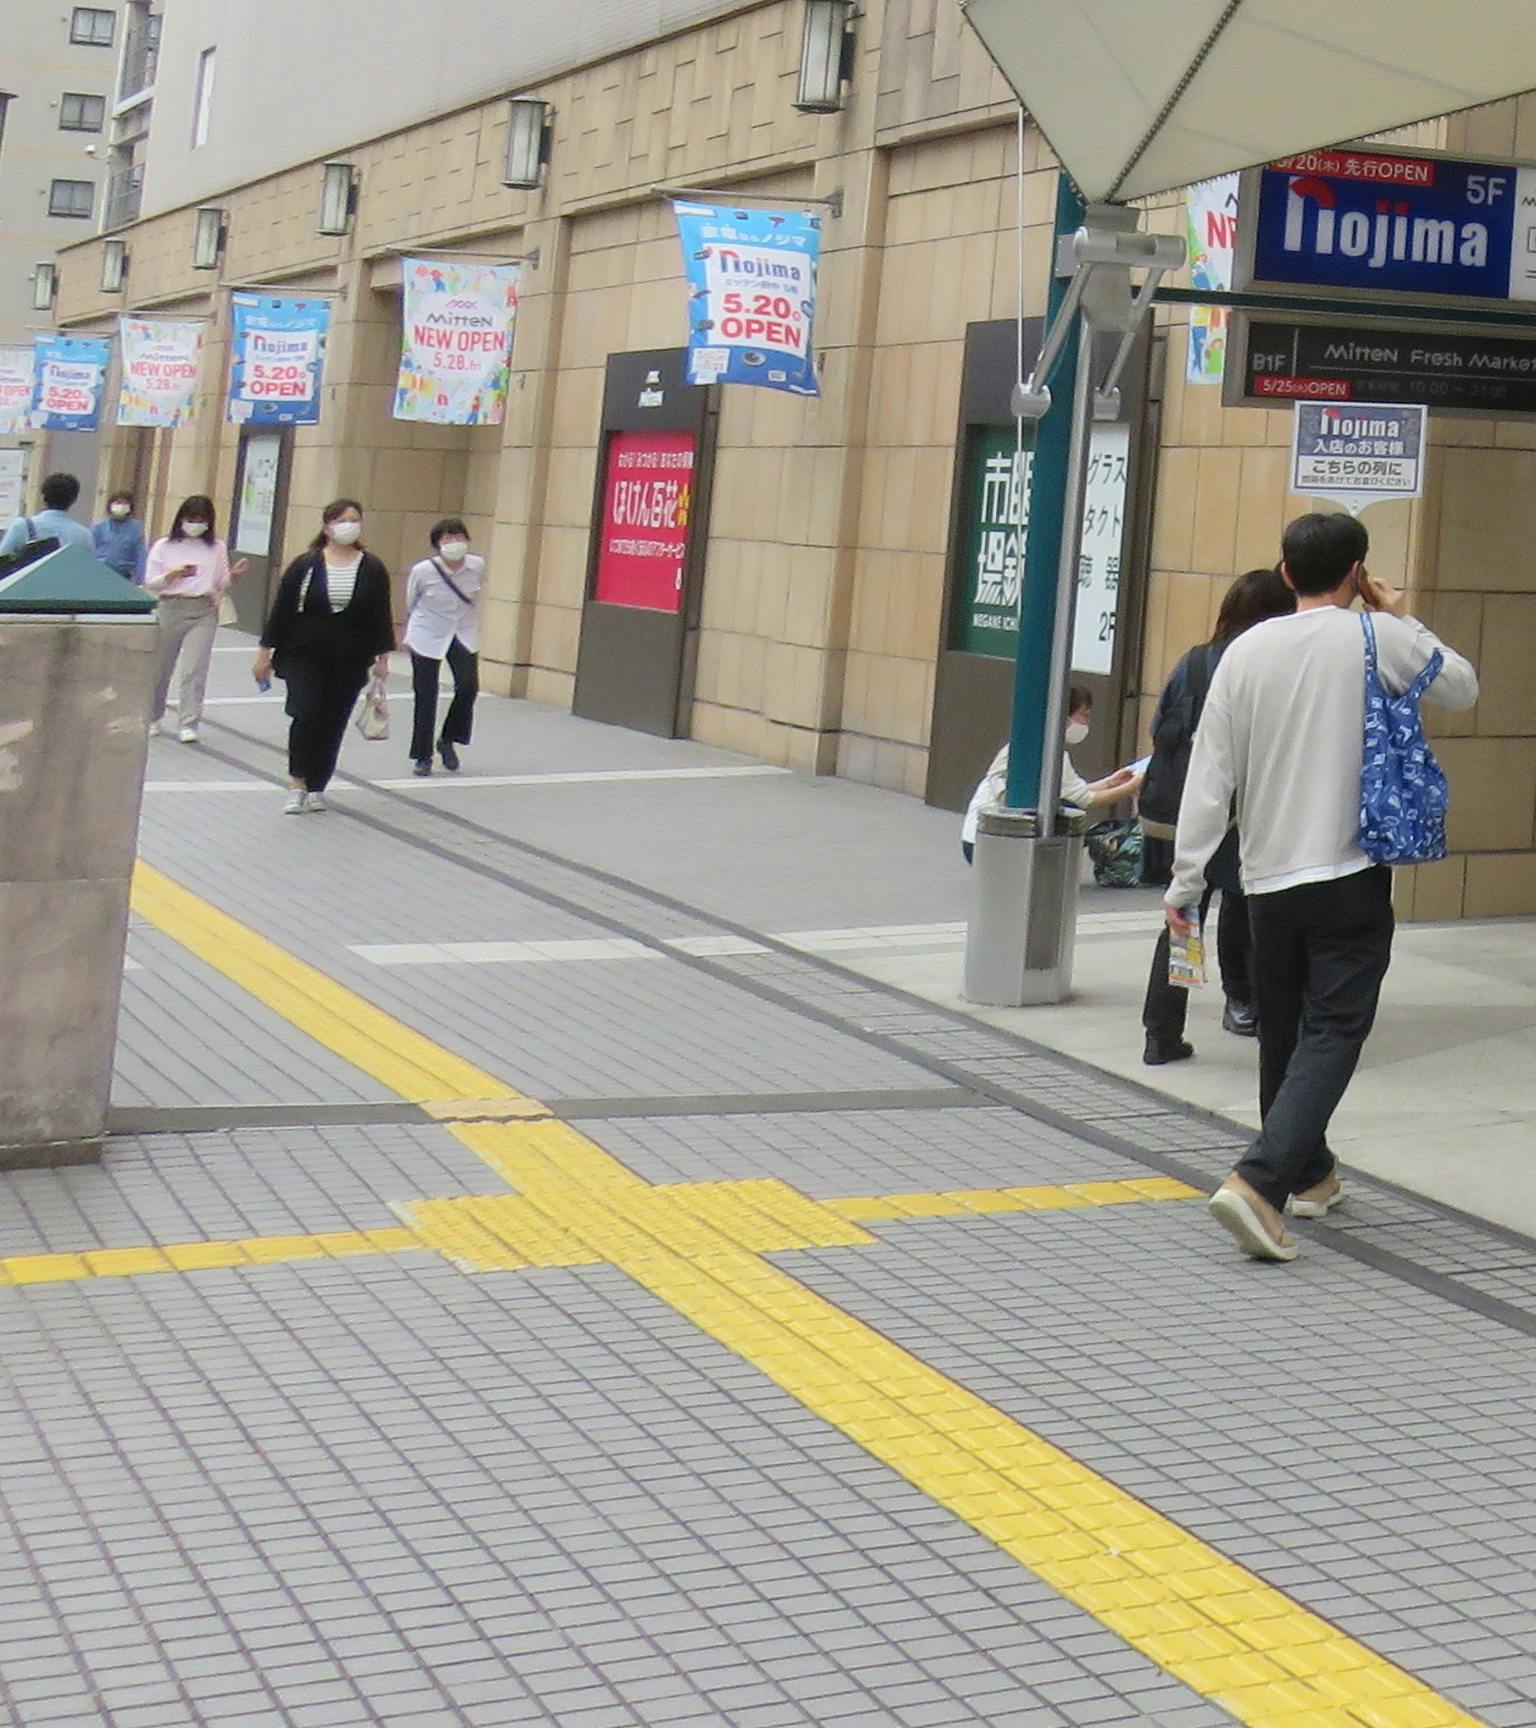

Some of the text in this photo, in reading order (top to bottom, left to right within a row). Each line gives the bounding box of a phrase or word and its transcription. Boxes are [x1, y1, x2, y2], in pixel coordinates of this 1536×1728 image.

[1345, 159, 1429, 181] 先行OPEN
[1465, 175, 1506, 206] 5F
[723, 293, 791, 319] 5.20
[414, 325, 504, 352] NEW OPEN
[721, 318, 800, 348] OPEN
[131, 362, 196, 378] NEW OPEN
[1252, 353, 1286, 372] B1F
[1411, 349, 1462, 367] Fresh
[250, 381, 305, 396] OPEN
[46, 400, 89, 411] OPEN
[1313, 439, 1404, 456] 入店のお客様
[1087, 453, 1126, 485] グラス
[1312, 459, 1402, 476] こちらの列に
[1084, 504, 1121, 538] タクト
